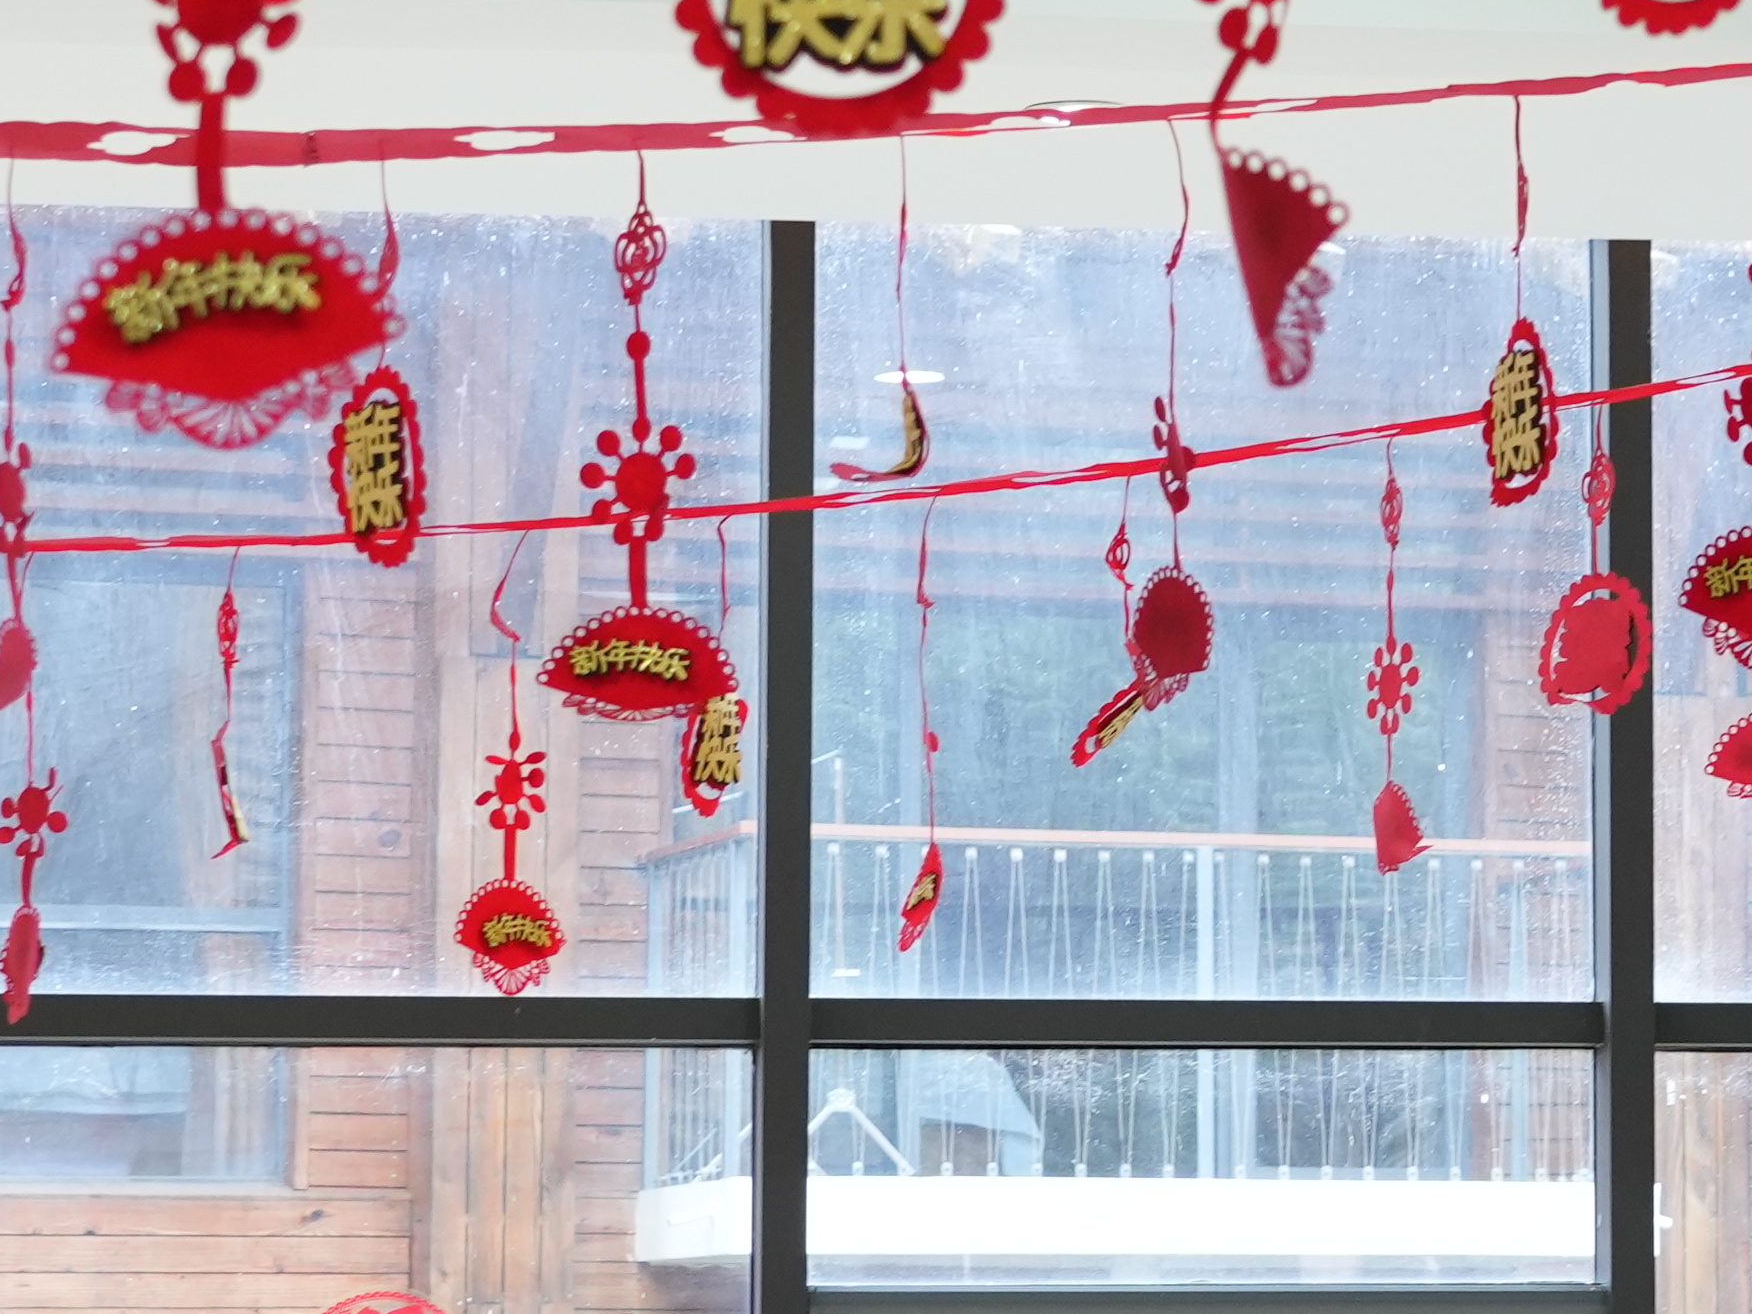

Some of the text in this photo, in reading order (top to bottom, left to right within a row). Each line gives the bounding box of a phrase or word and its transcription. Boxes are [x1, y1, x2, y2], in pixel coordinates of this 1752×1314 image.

[108, 251, 321, 343] 新年快乐
[570, 639, 691, 680] 新年快乐
